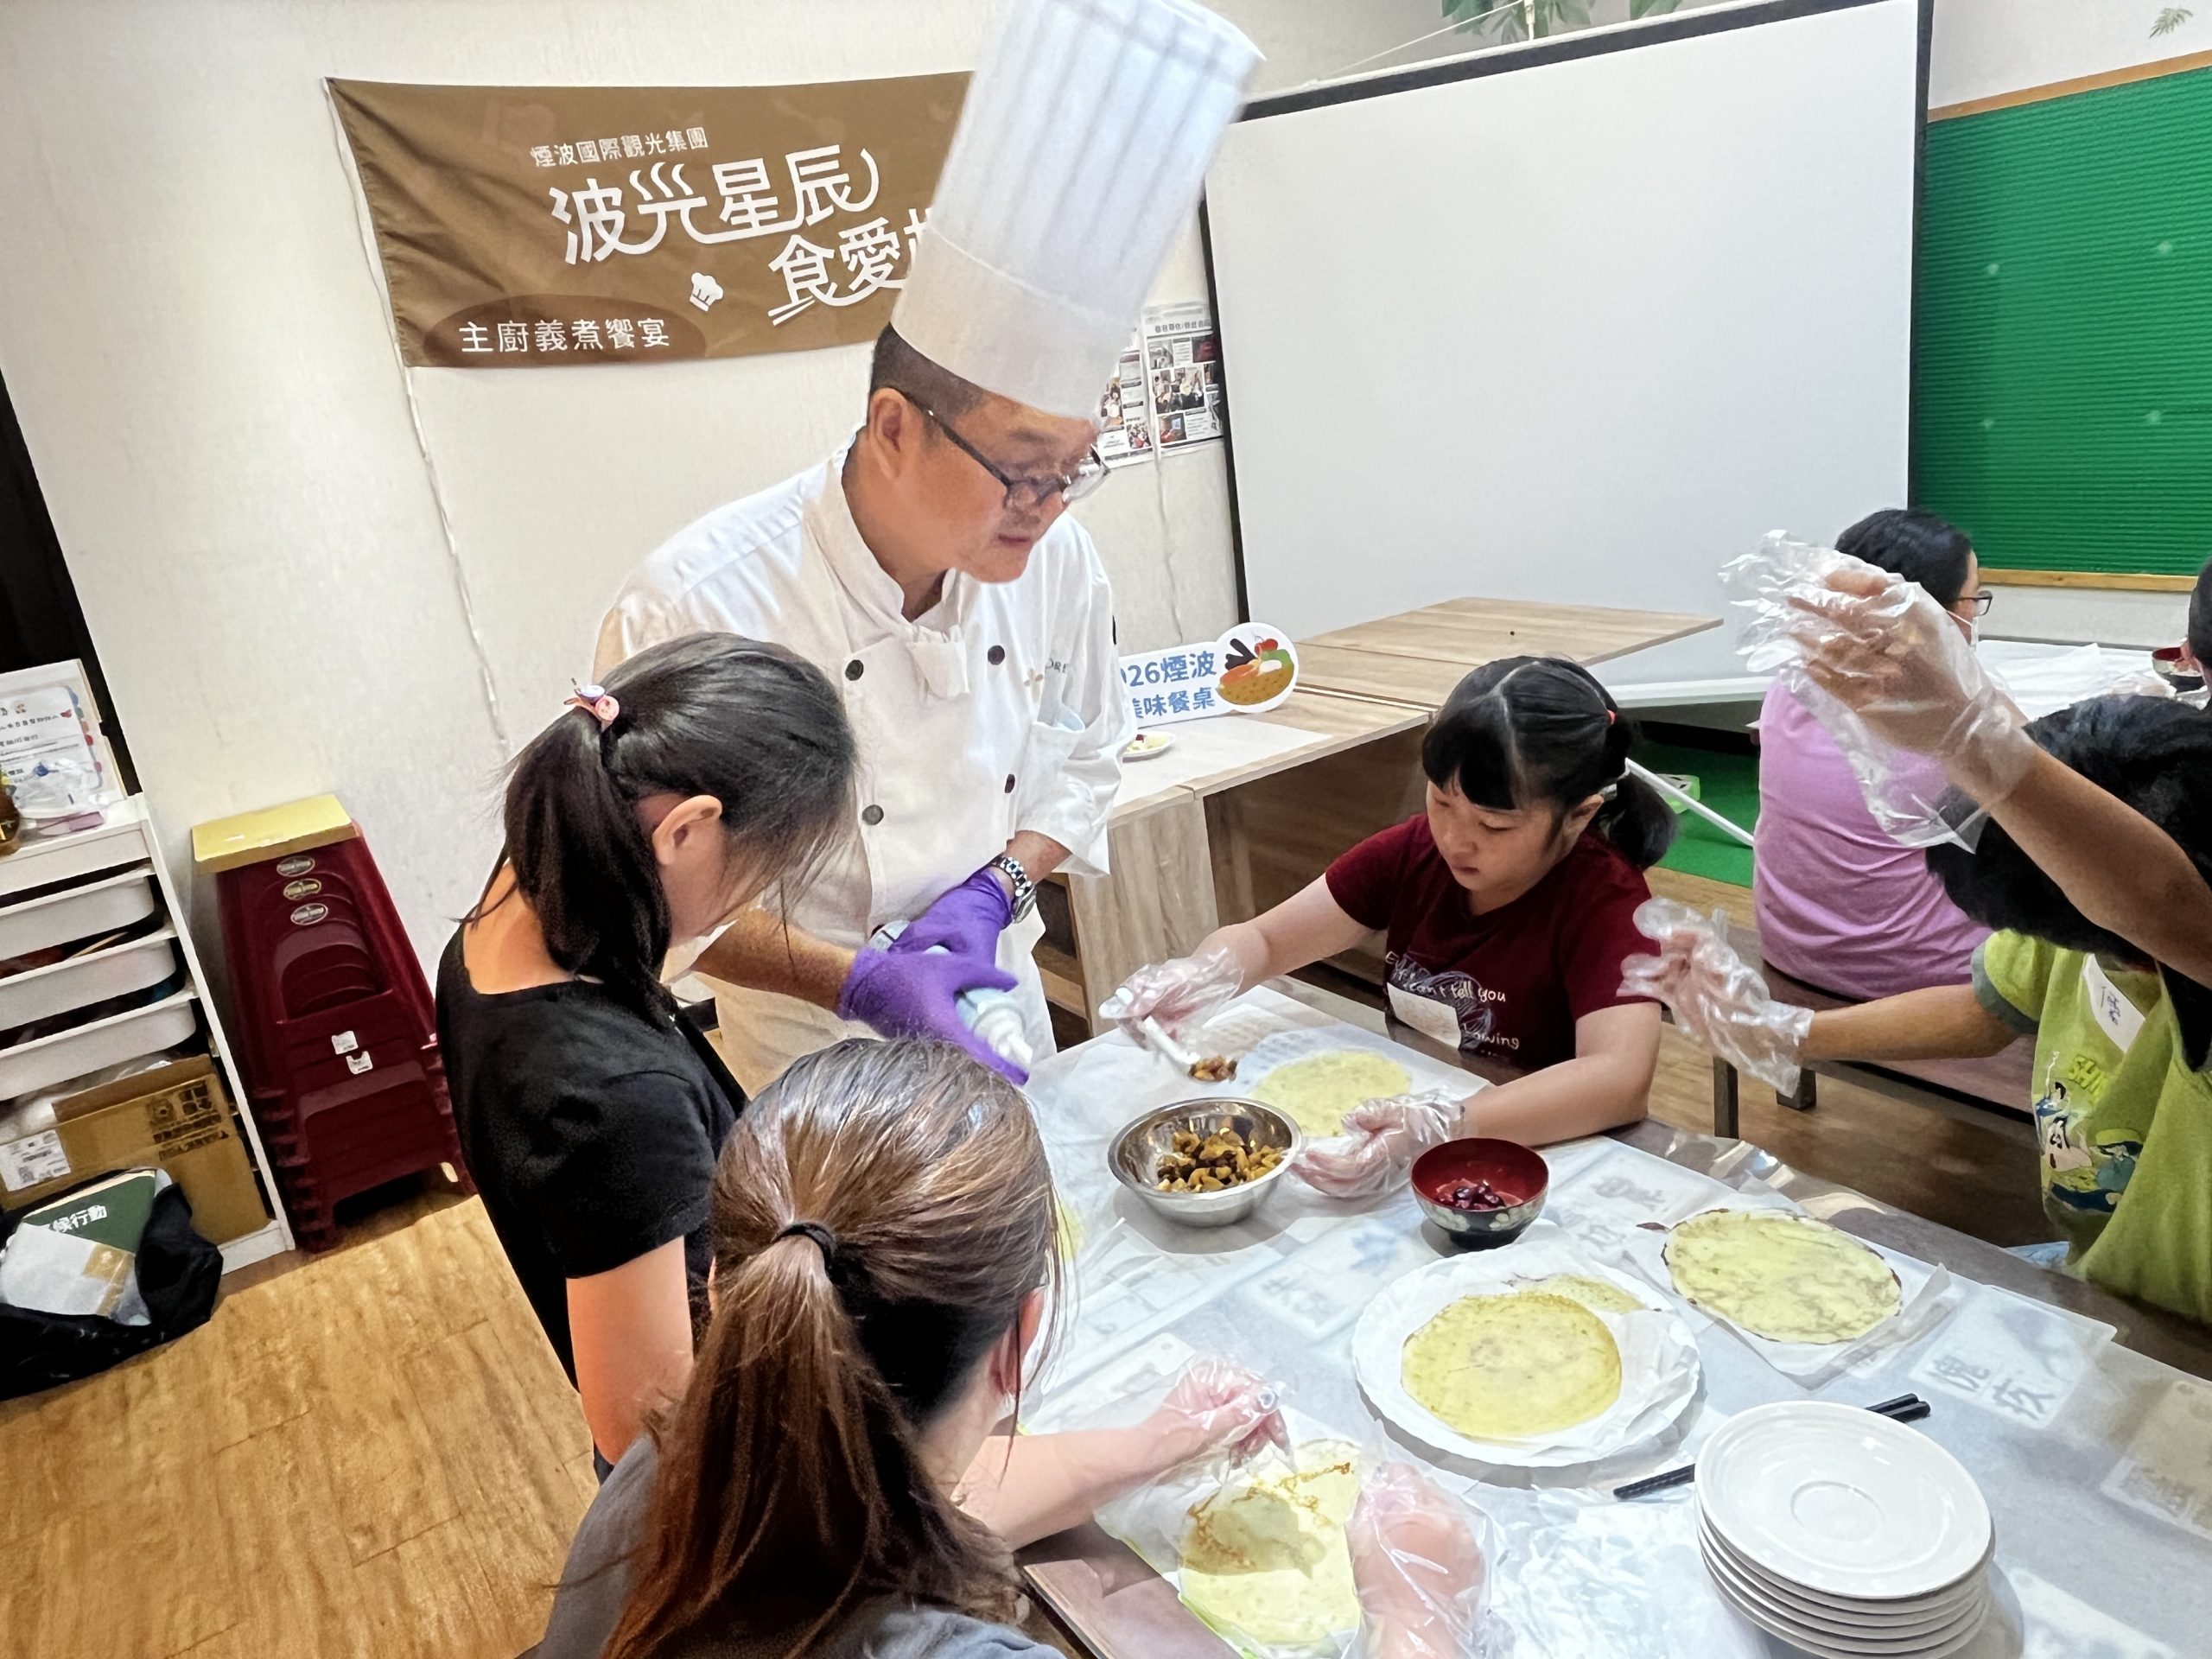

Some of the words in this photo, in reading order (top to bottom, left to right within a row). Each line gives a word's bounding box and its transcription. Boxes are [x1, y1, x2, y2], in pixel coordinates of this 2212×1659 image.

[530, 127, 708, 167] 煙波國際觀光集團
[459, 317, 670, 353] 主廚義煮饗宴
[1478, 987, 1506, 1003] you
